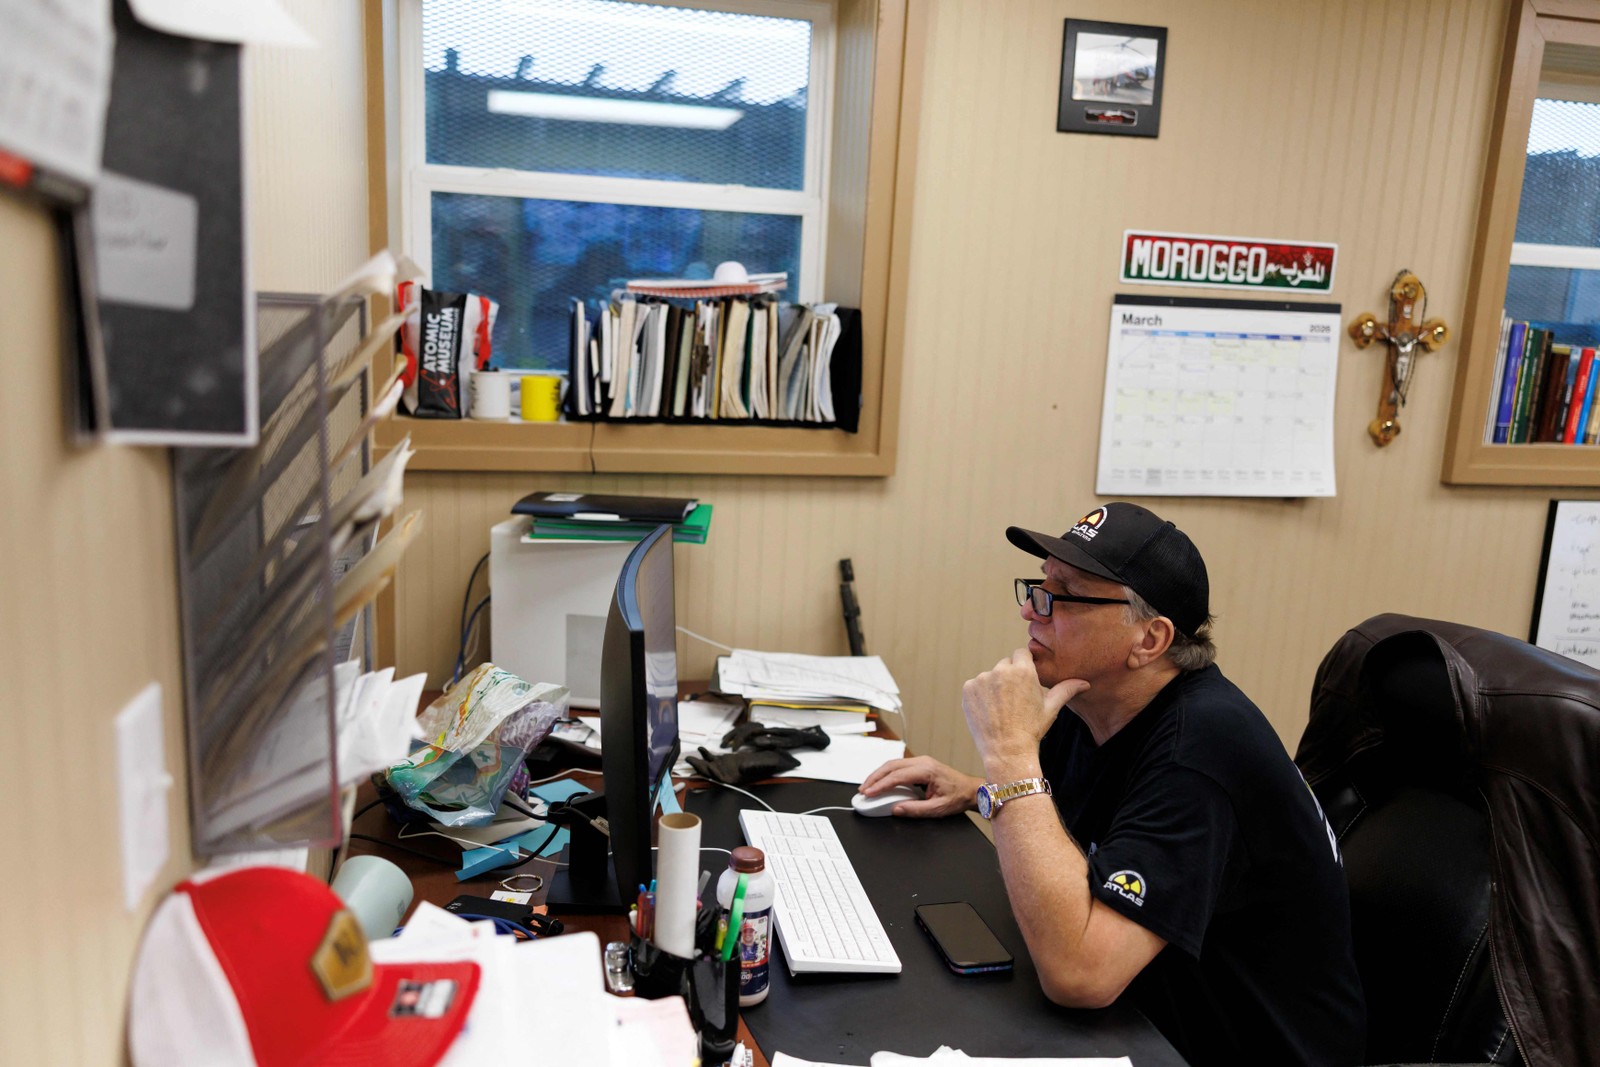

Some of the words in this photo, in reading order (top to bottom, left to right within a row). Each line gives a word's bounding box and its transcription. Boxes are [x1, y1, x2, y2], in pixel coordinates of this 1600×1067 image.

[1130, 239, 1267, 284] MOROCCO
[1121, 313, 1163, 327] March
[423, 313, 440, 372] ATOMIC
[437, 307, 454, 374] MUSEUM
[1073, 522, 1098, 538] LAS
[1103, 881, 1144, 907] ATLAS
